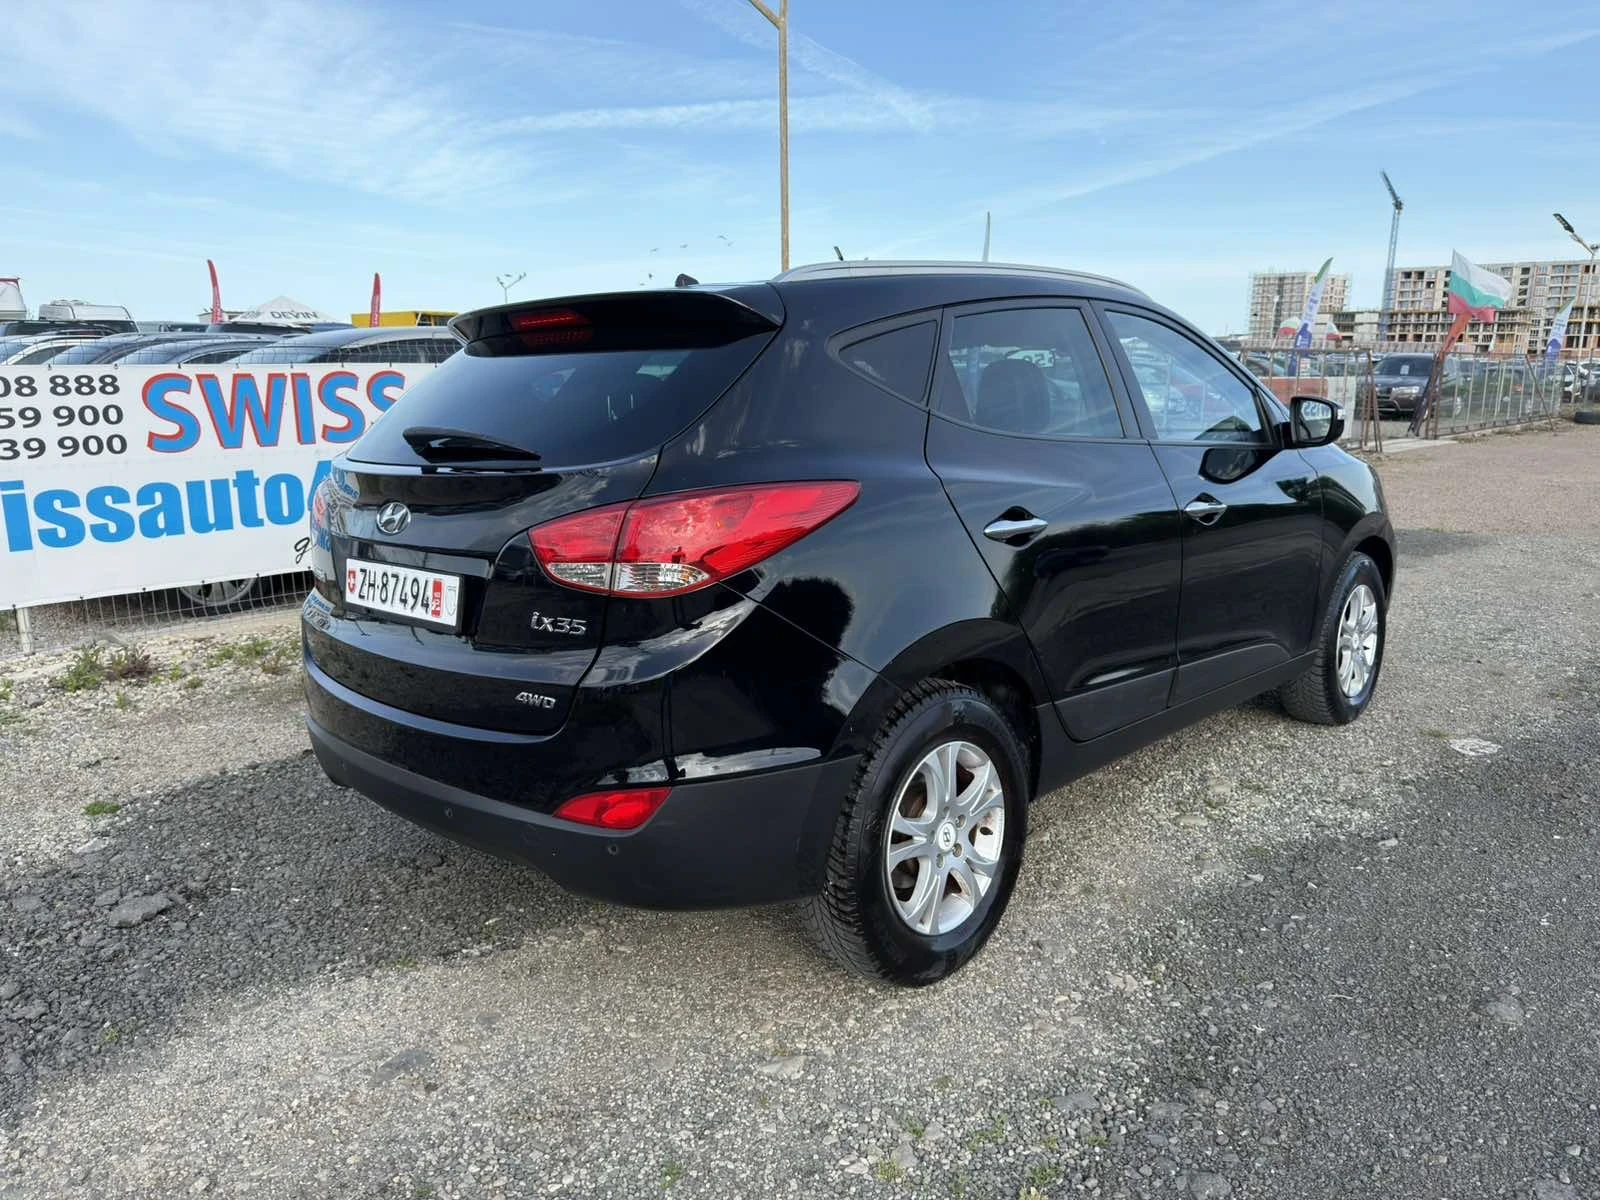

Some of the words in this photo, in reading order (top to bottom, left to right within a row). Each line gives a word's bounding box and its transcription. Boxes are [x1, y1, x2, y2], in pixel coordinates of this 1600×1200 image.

[270, 310, 318, 320] DEVIN
[49, 374, 120, 396] 888
[0, 406, 41, 429] 59
[53, 404, 124, 427] 900
[0, 434, 46, 460] 39
[57, 434, 128, 458] 900
[530, 611, 587, 635] ix35
[515, 691, 556, 709] 4WD
